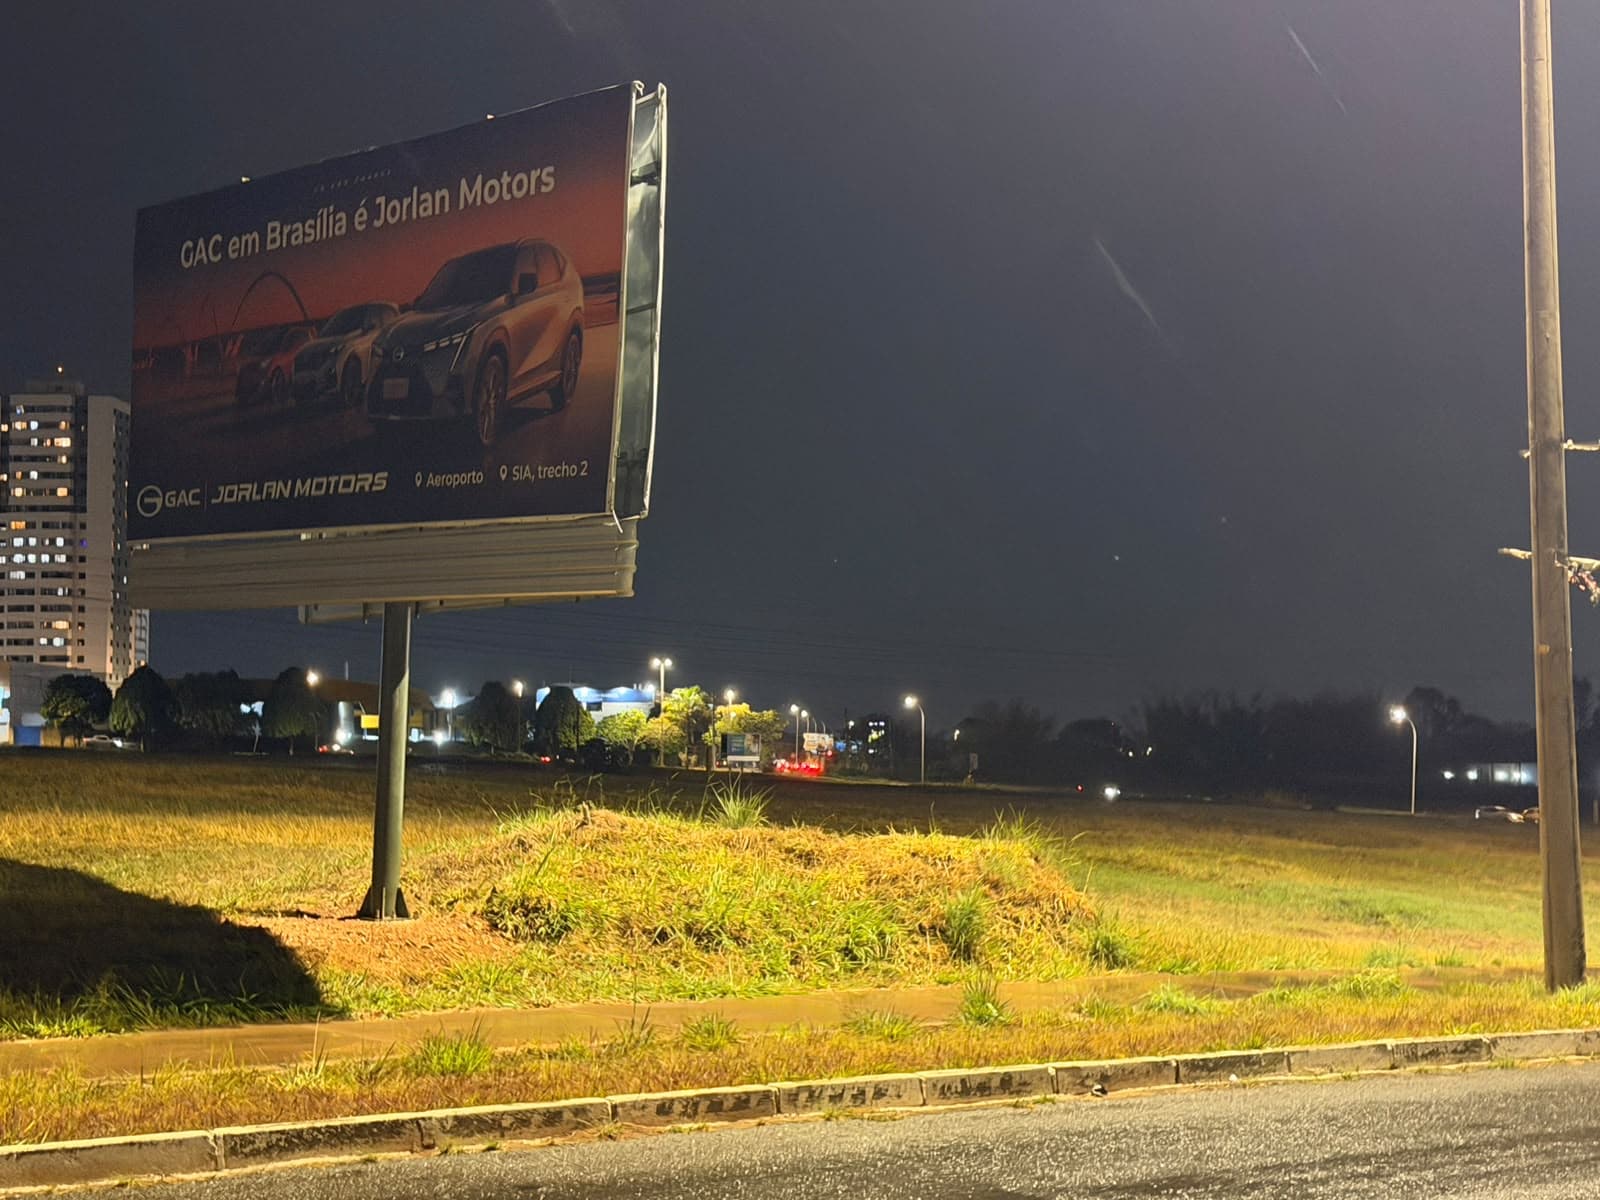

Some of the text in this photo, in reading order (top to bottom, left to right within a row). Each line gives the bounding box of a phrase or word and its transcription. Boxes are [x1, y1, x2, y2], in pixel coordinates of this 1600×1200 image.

[180, 165, 555, 268] GAC em Brasília é Jorlan Motors
[426, 471, 484, 488] Aeroporto
[512, 460, 588, 483] SIA, trecho 2
[165, 488, 201, 508] GAC
[211, 471, 389, 504] JORLAN MOTORS
